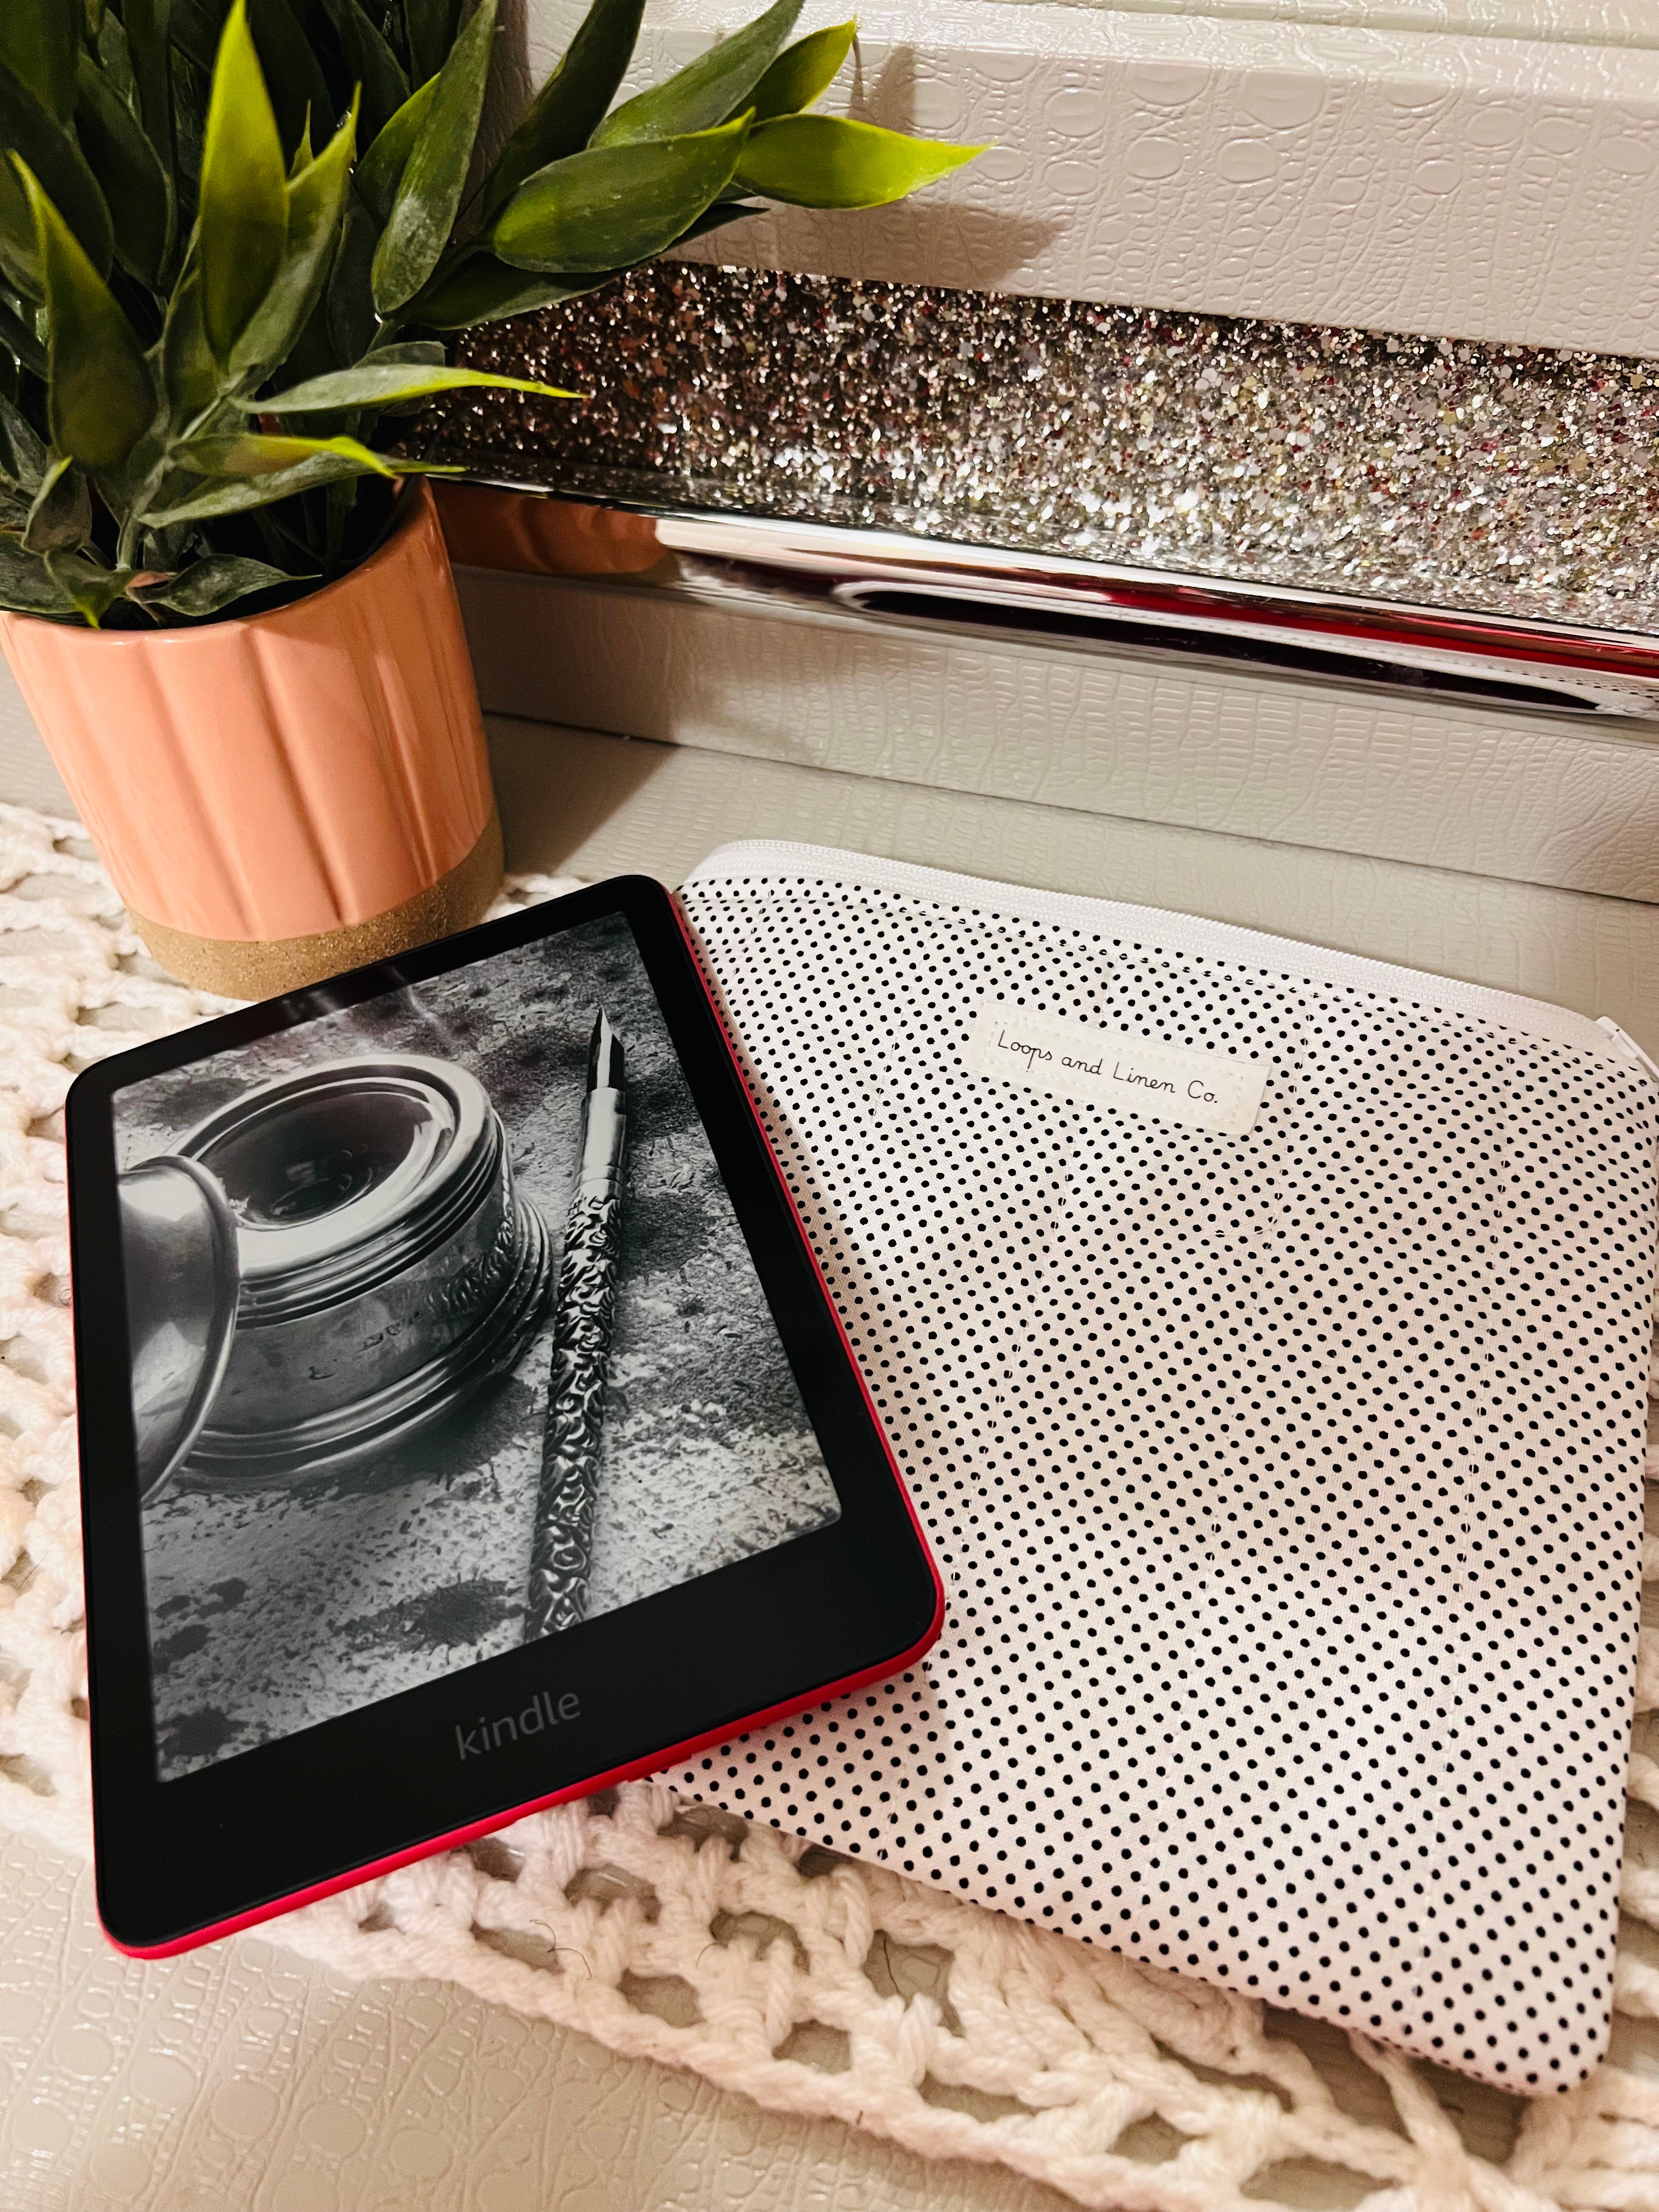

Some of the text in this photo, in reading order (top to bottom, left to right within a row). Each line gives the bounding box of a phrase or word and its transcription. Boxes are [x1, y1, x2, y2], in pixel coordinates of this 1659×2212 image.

[997, 1029, 1218, 1104] Loops and Linen Co.
[456, 1691, 581, 1760] kindle
